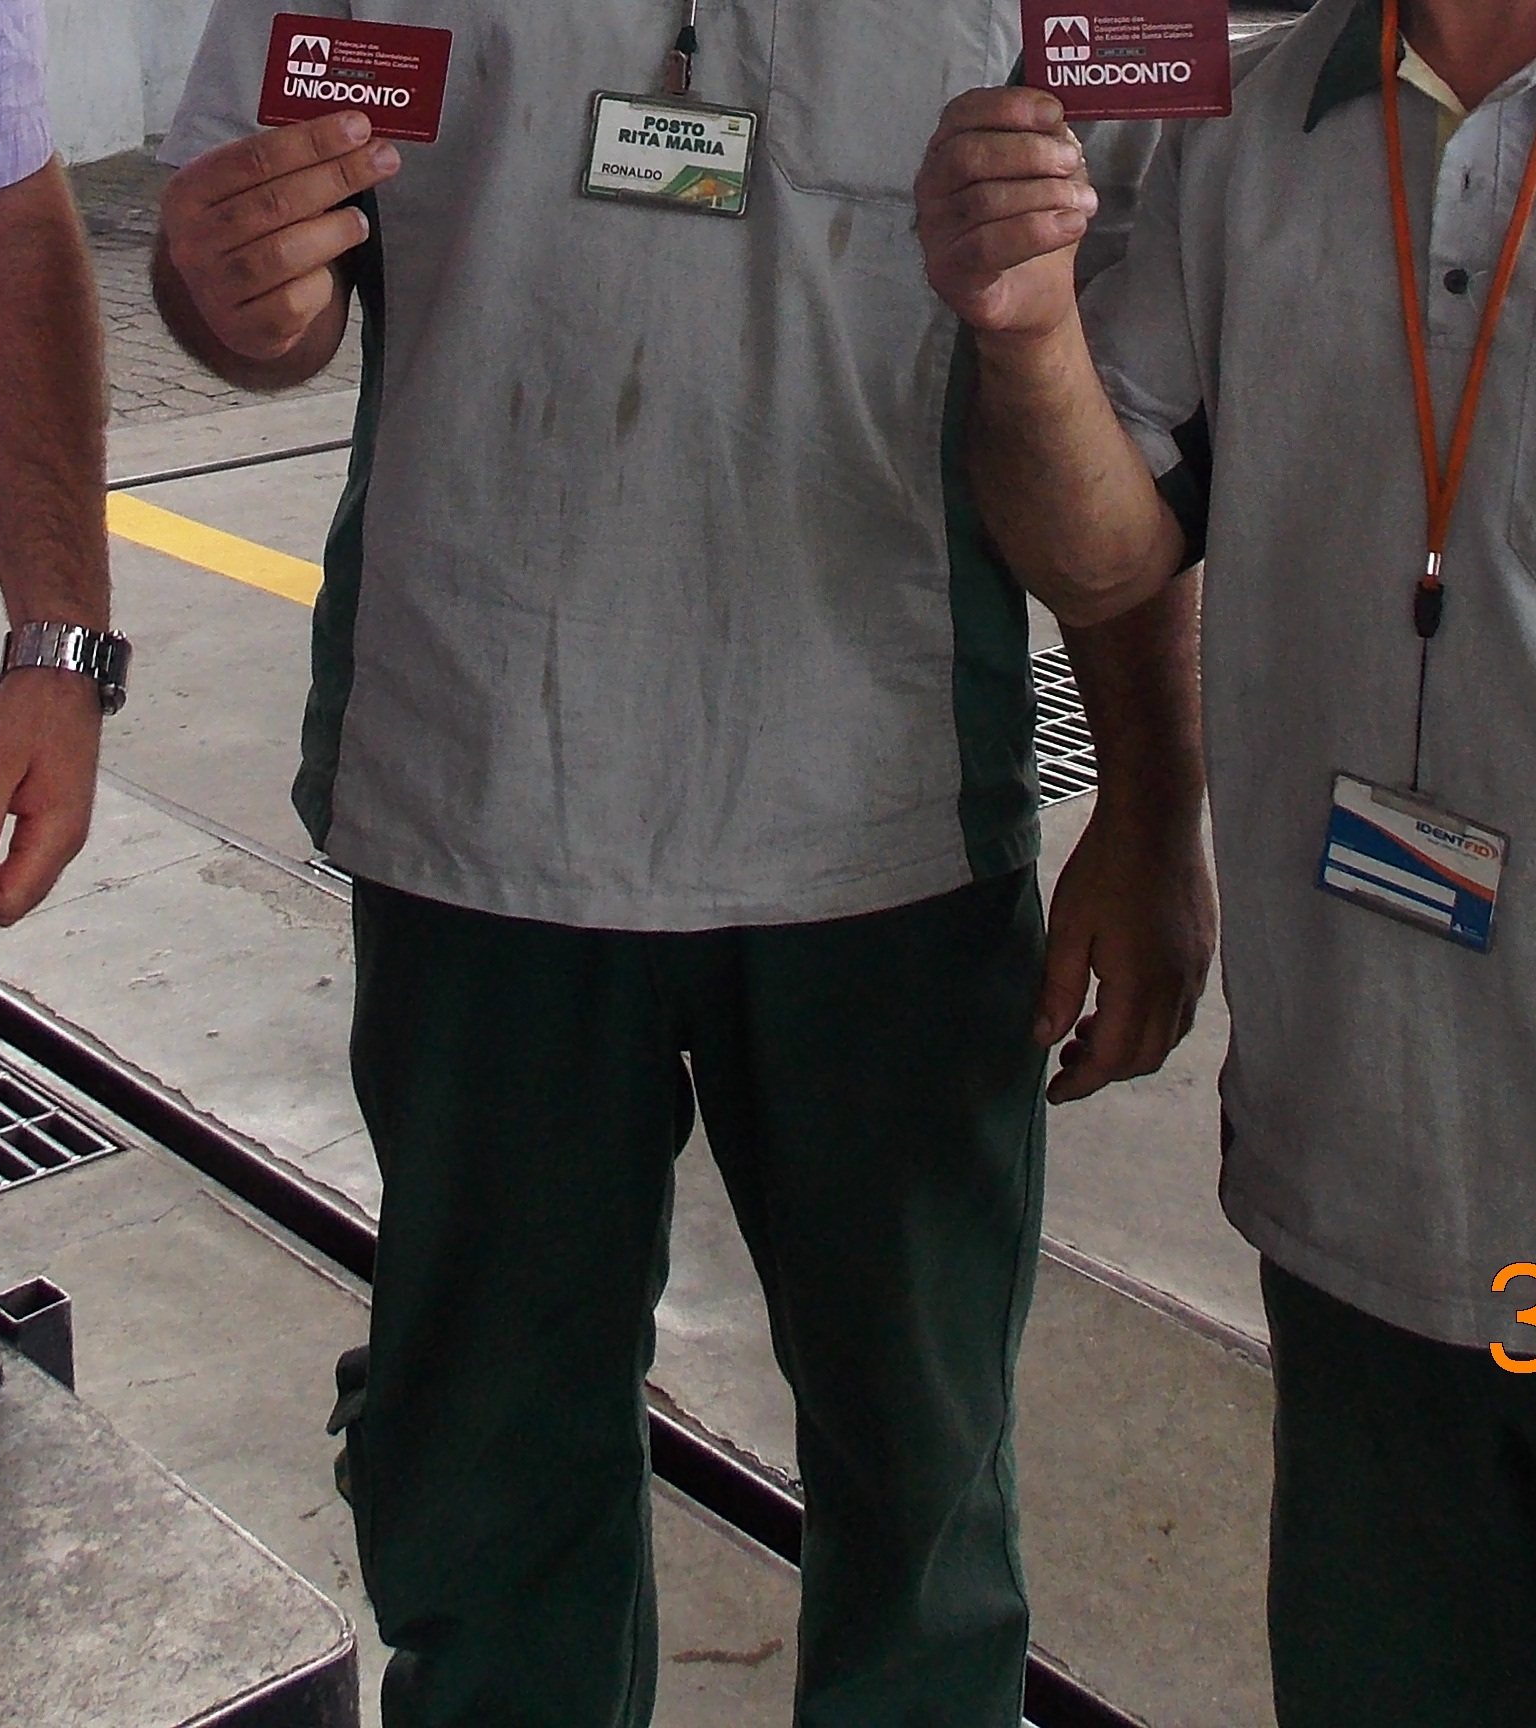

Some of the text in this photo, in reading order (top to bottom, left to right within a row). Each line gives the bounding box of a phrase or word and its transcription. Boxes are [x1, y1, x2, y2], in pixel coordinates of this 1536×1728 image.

[1046, 60, 1192, 88] UNIODONTO
[282, 76, 411, 109] UNIODONTO
[643, 115, 706, 137] POSTO
[618, 128, 661, 148] RITA
[665, 134, 725, 157] MARIA
[601, 162, 663, 181] RONALDO
